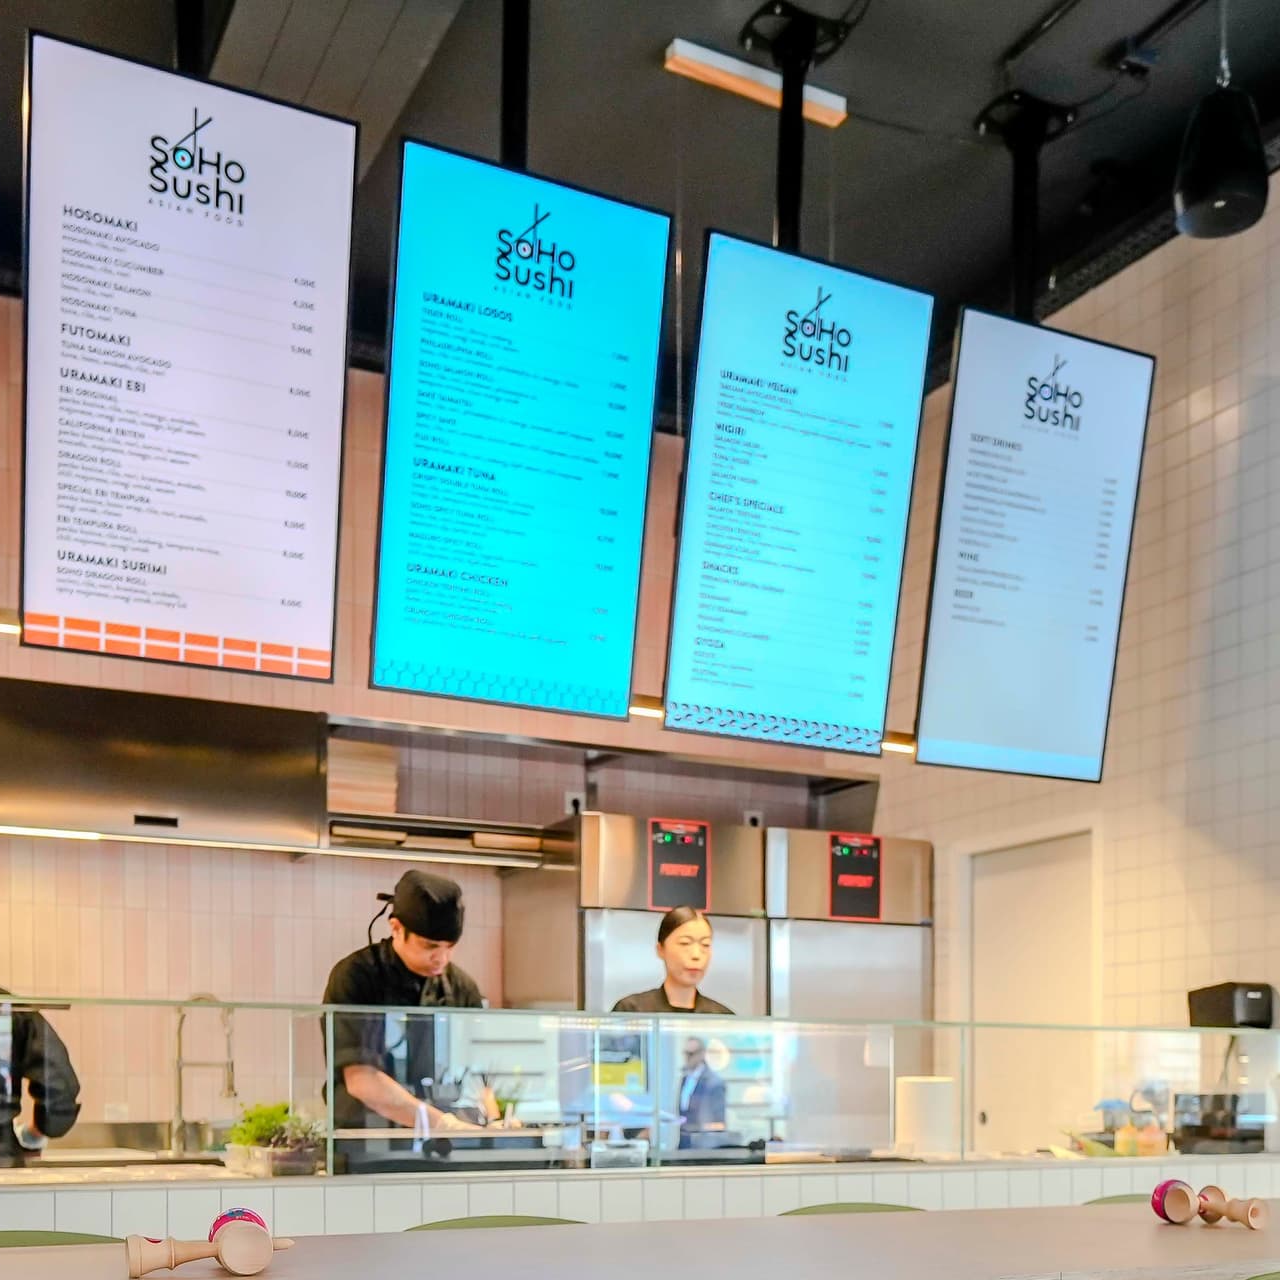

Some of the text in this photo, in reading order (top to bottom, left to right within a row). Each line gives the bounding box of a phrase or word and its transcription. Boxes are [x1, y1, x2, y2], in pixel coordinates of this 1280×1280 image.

[62, 205, 138, 232] HOSOMAKI
[422, 292, 513, 322] URAMAKI LOSOS
[60, 322, 131, 346] FUTOMAKI
[59, 367, 146, 393] URAMAKI EBI
[56, 549, 167, 575] URAMAKI SURIMI
